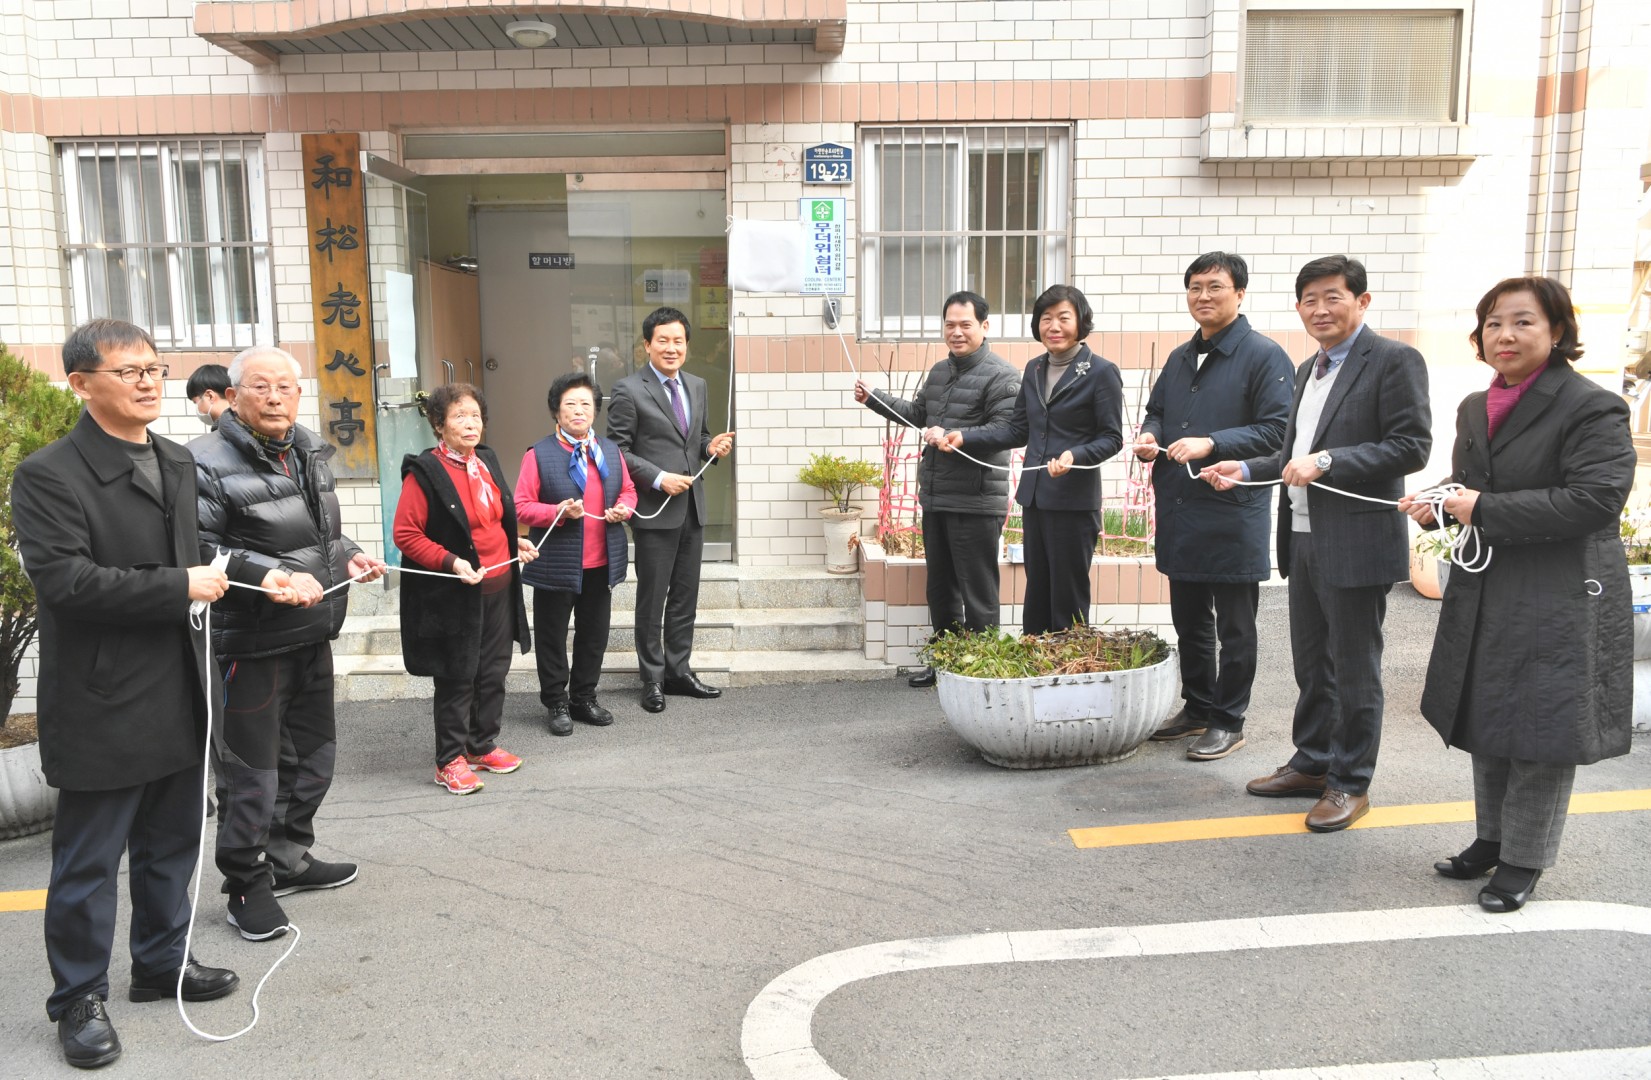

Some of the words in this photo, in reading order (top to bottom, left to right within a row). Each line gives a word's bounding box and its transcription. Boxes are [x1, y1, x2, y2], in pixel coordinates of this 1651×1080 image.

[810, 163, 848, 179] 19-23
[814, 222, 831, 275] 무더위쉼터
[531, 256, 573, 266] 할머니방
